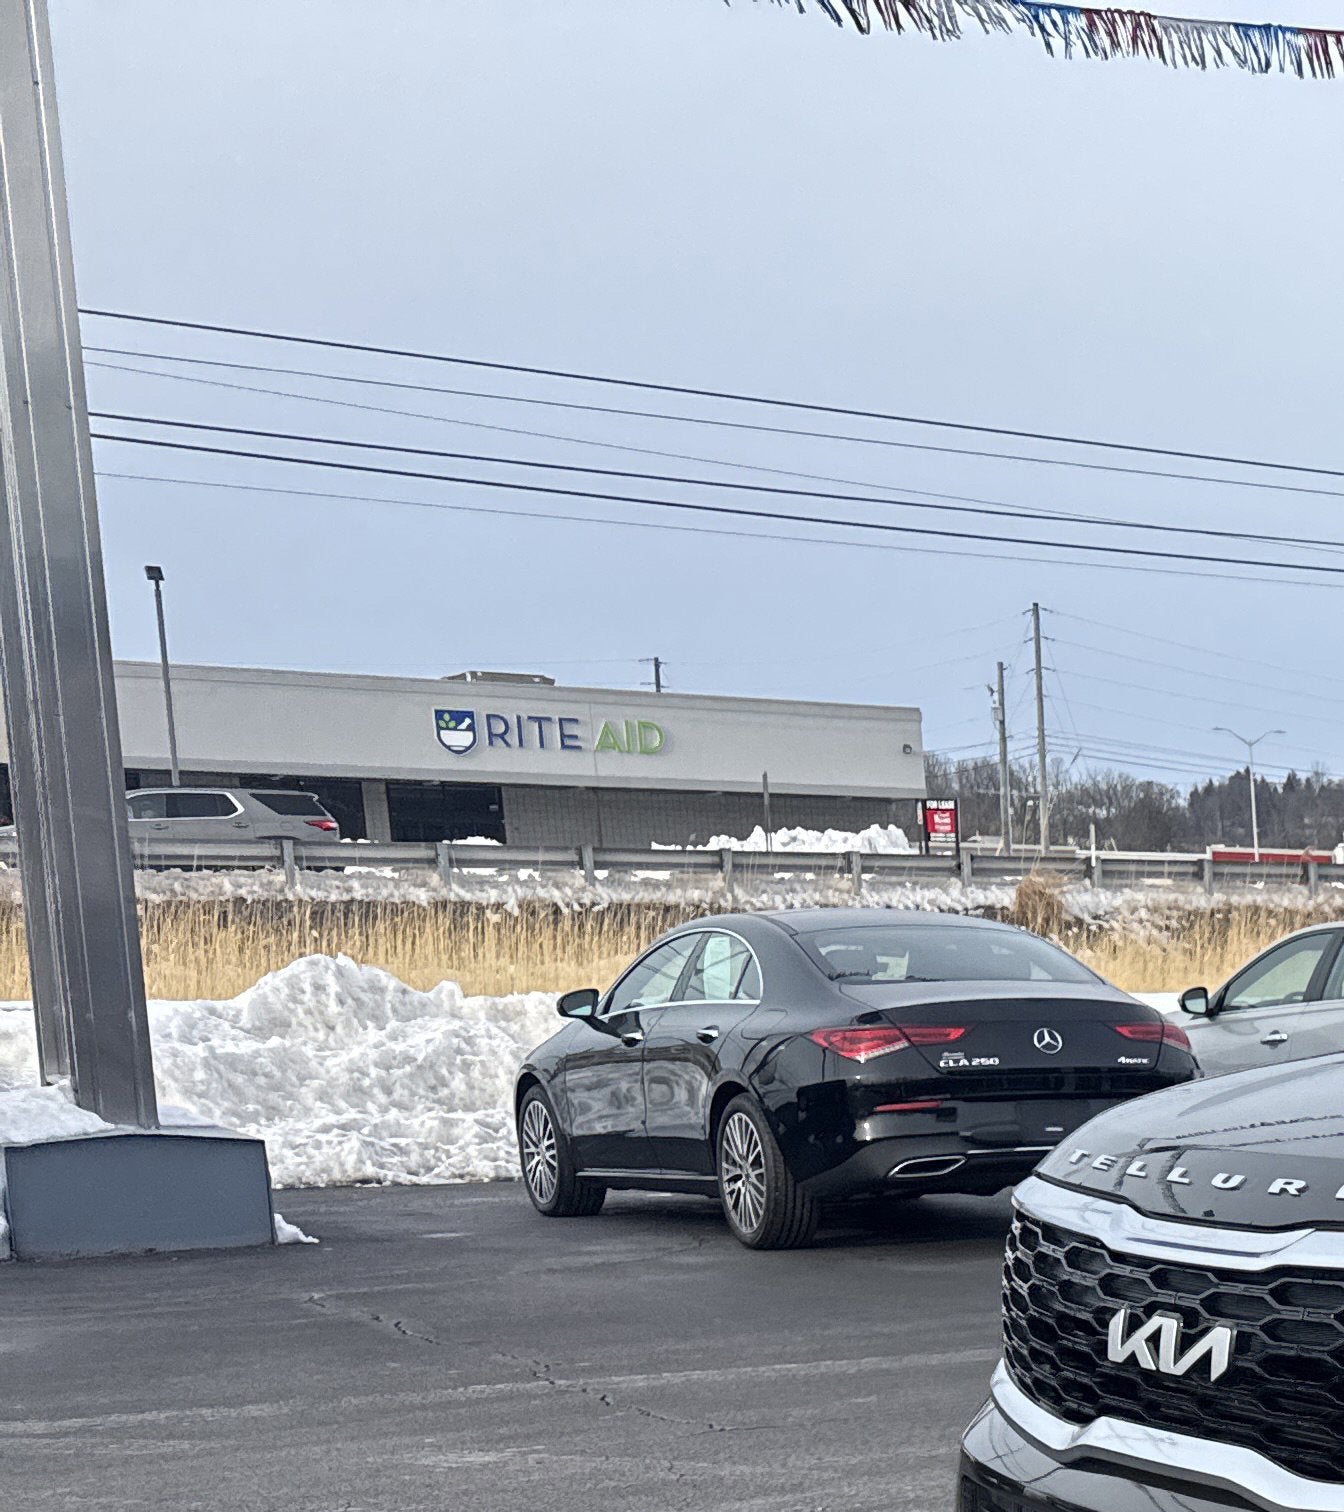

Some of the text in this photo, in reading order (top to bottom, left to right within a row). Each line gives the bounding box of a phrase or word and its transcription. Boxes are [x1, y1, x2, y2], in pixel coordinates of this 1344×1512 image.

[486, 714, 664, 754] RITE AID
[940, 1057, 999, 1067] CLA 250
[1108, 1308, 1236, 1383] KIA
